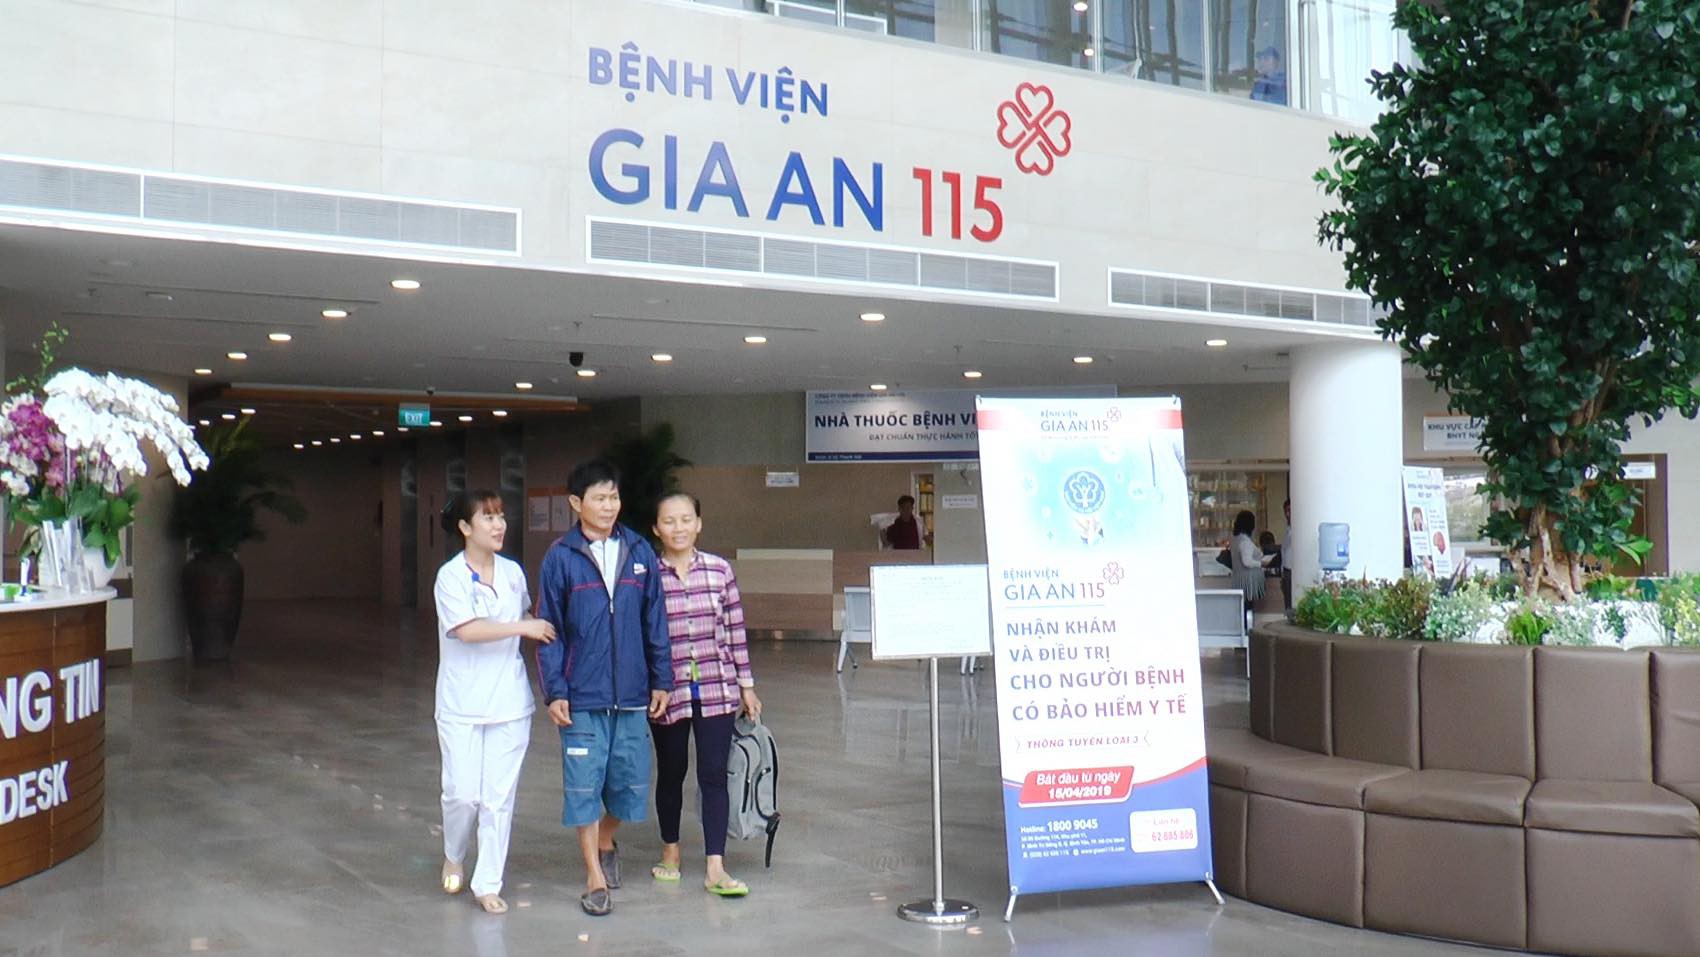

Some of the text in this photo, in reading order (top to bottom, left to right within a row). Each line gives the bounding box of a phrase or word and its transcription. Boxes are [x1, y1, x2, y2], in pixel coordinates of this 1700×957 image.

[588, 41, 828, 123] BỆNH VIỆN
[588, 128, 1003, 242] GIA AN 115
[405, 411, 423, 425] EXIT
[814, 410, 977, 429] NHÀ THUỐC BỆNH VI
[1041, 419, 1108, 431] GIA AN 115
[1003, 568, 1059, 581] BỆNH VIỆN
[1004, 582, 1105, 600] GIA AN 115
[1007, 616, 1116, 639] NHẬN KHÁM
[1009, 642, 1110, 662] VÀ ĐIỀU TRỊ
[1010, 665, 1185, 690] CHO NGƯỜI BỆNH
[60, 658, 100, 725] TIN
[1012, 693, 1188, 721] CÓ BẢO HIỂM Y TẾ
[0, 760, 69, 825] DESK
[1047, 820, 1071, 832] 1800
[1073, 818, 1098, 830] 9045
